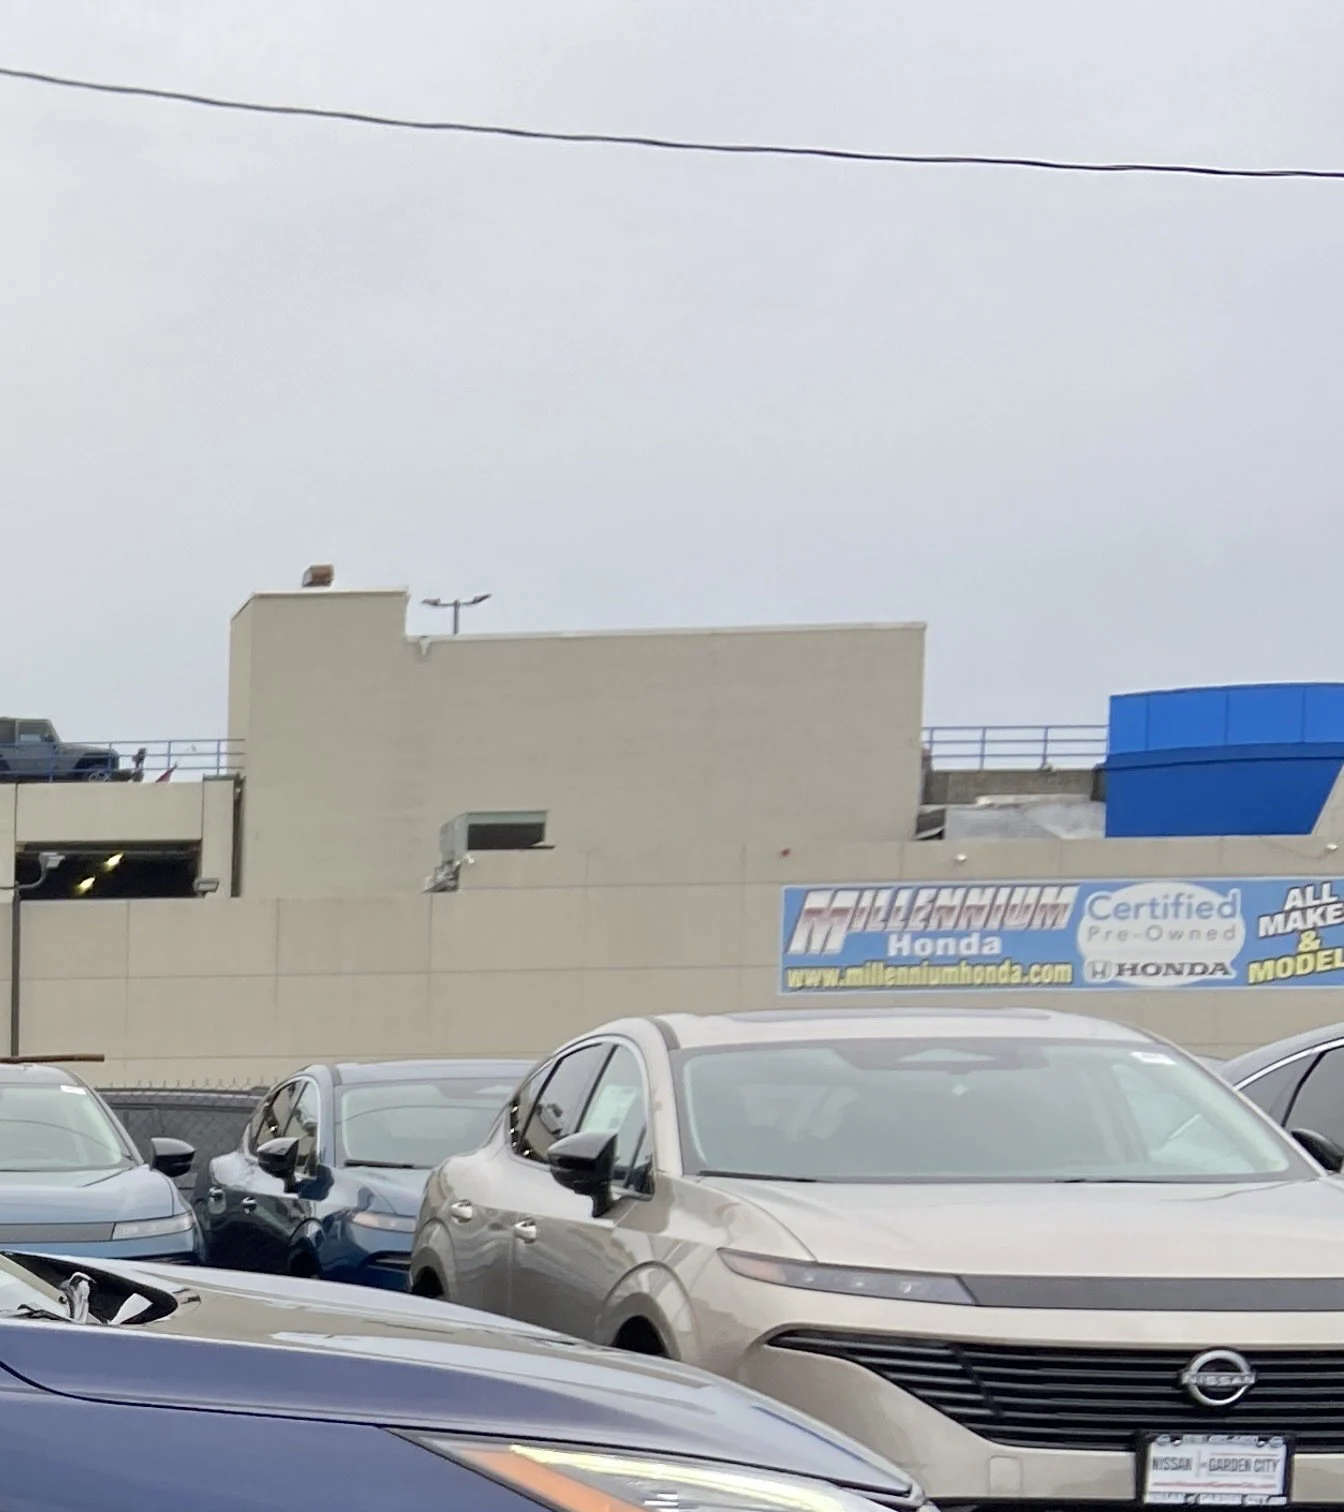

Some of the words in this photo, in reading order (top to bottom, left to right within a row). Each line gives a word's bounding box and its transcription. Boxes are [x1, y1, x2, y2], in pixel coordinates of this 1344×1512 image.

[1088, 891, 1238, 921] Certified
[1283, 880, 1339, 911] ALL
[787, 885, 1081, 956] MILLENNIUM
[887, 932, 1002, 956] Honda
[1086, 924, 1237, 943] Pre-Owned
[1298, 930, 1322, 952] &
[786, 957, 1074, 988] www.millenniumhonda.com
[1115, 962, 1232, 977] HONDA
[1182, 1374, 1255, 1385] NISSAN
[1152, 1456, 1193, 1472] NISSAN
[1208, 1458, 1252, 1473] GARDEN
[1254, 1458, 1281, 1474] CITY
